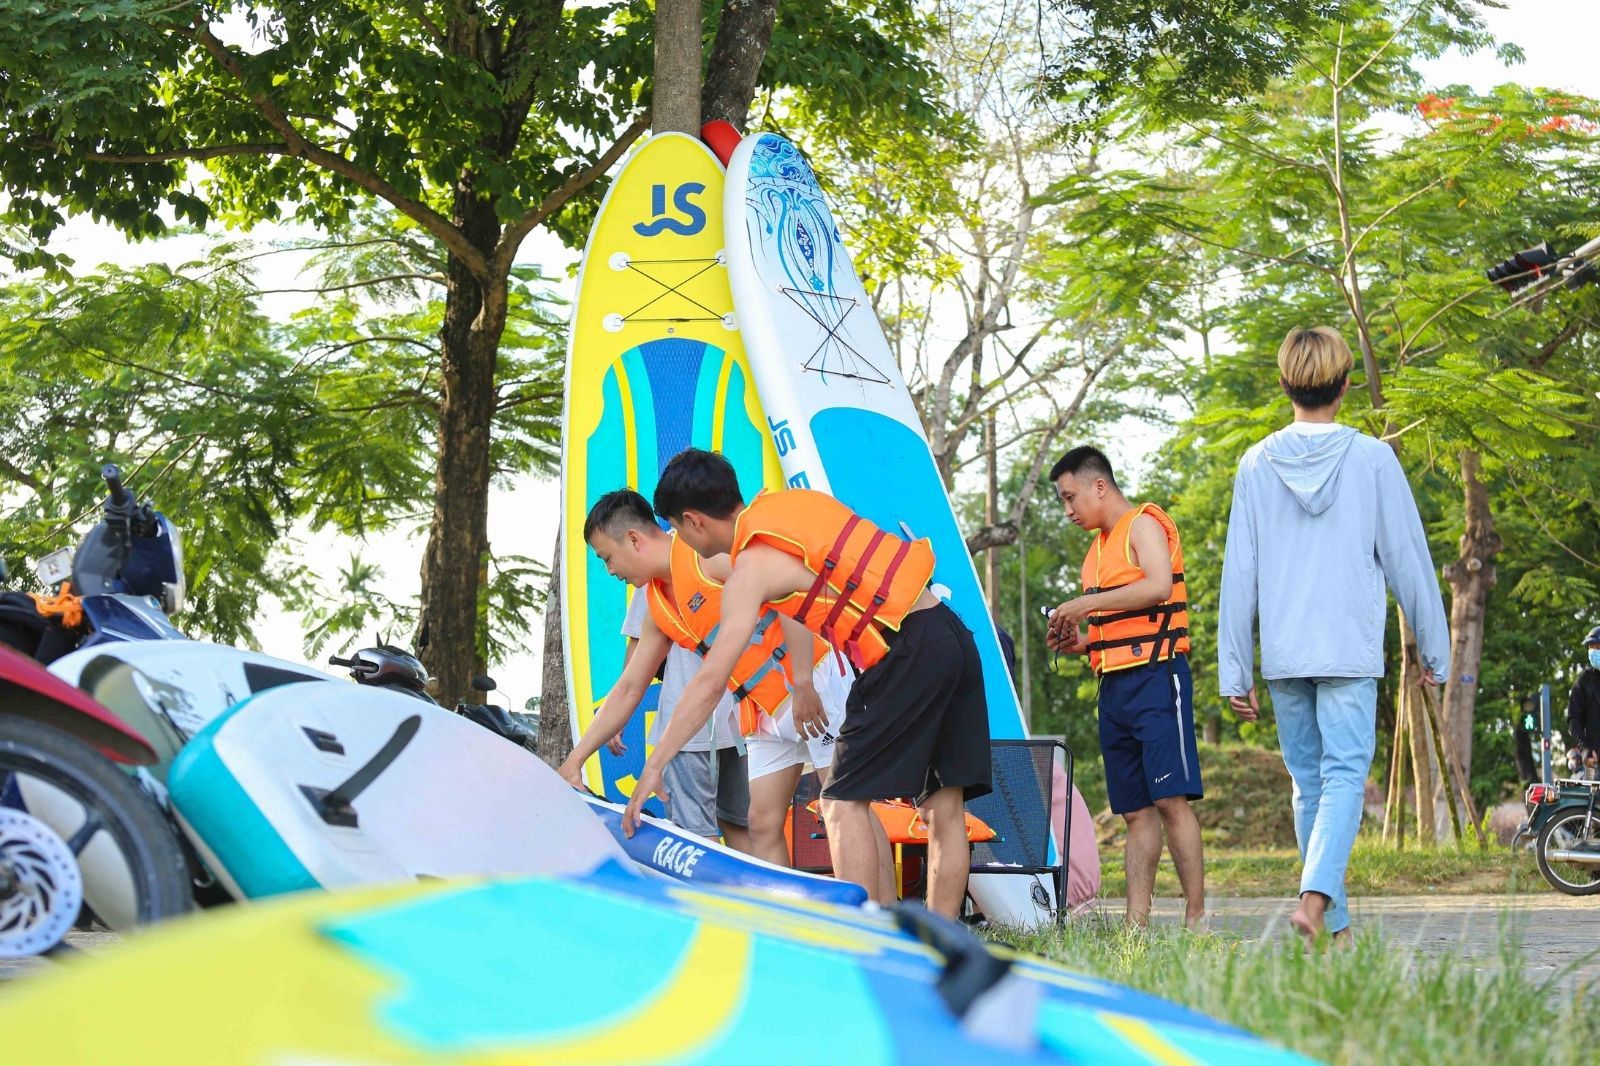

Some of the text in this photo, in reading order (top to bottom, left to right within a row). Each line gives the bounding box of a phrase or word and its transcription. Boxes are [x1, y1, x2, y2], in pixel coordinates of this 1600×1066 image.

[633, 182, 707, 236] JS
[767, 415, 797, 457] JS
[652, 836, 707, 878] RACE
